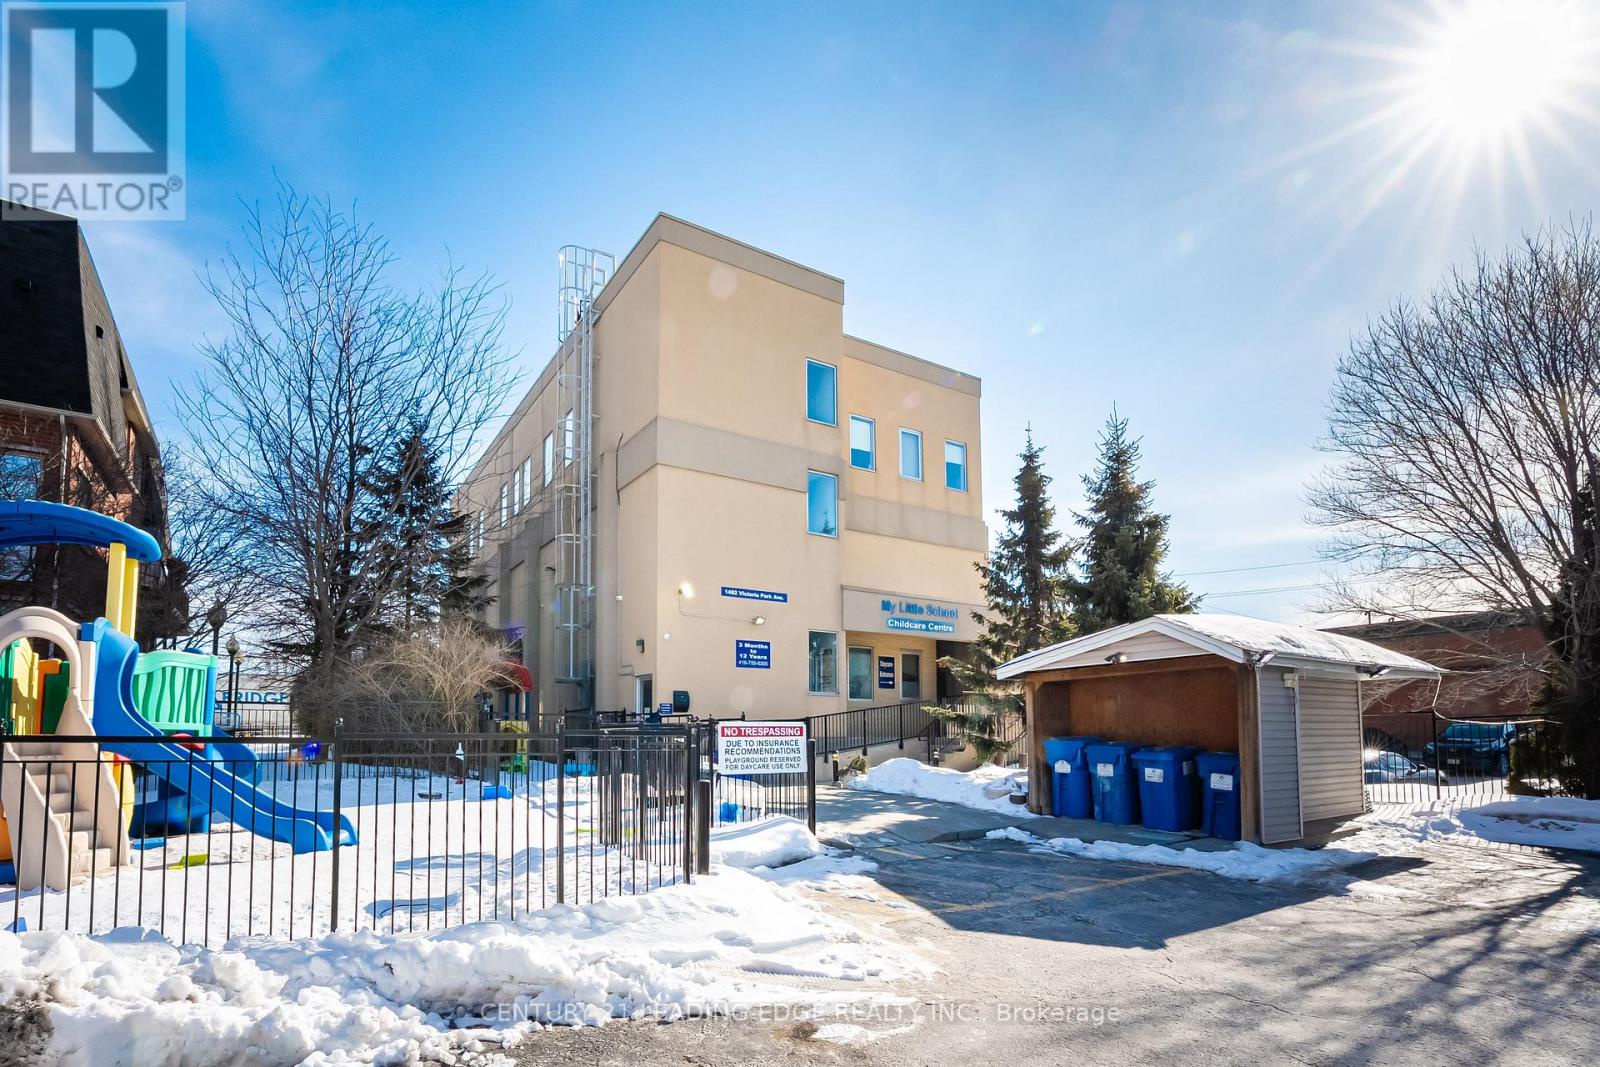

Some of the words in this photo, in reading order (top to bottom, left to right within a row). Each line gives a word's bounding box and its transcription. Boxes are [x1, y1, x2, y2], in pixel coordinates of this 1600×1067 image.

[881, 600, 896, 614] My
[899, 602, 924, 615] Little
[926, 604, 958, 618] School
[888, 619, 926, 630] Childcare
[928, 622, 954, 632] Centre
[724, 727, 738, 736] NO
[740, 726, 800, 736] TRESPASSING
[724, 747, 800, 756] RECOMMENDATIONS
